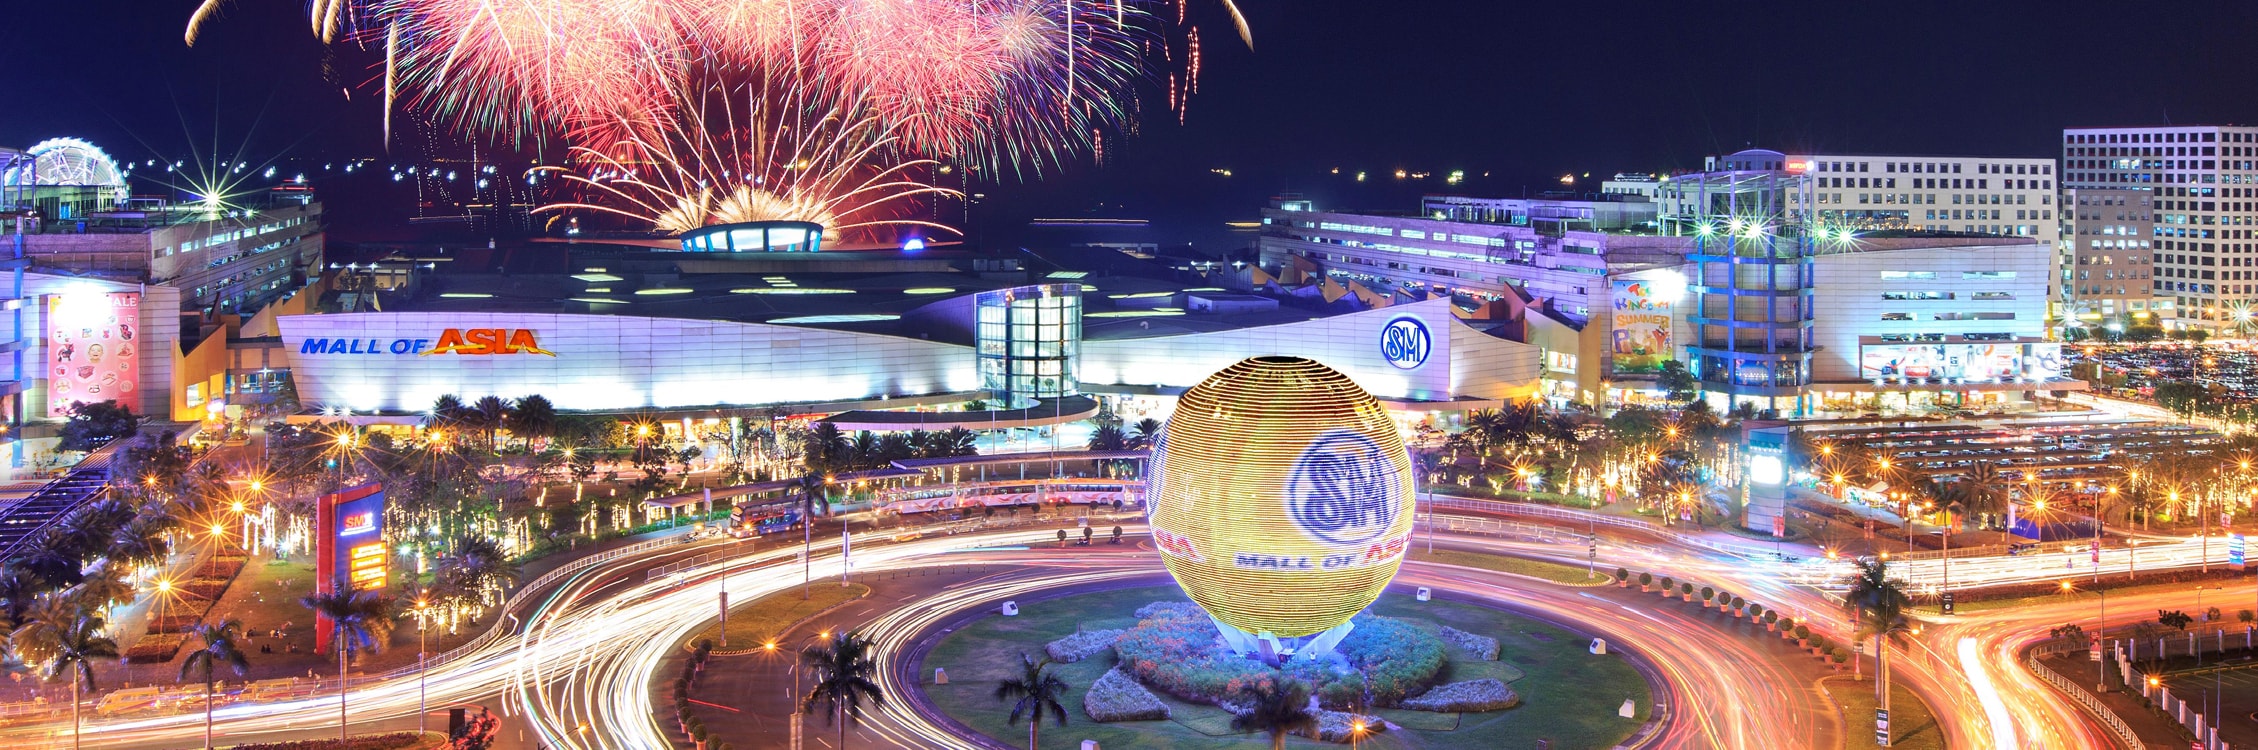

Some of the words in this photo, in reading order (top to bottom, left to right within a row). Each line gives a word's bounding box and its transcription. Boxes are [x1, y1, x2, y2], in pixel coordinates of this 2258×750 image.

[1616, 314, 1670, 328] SUMMER
[301, 338, 381, 354] MALL
[390, 338, 429, 354] OF
[432, 328, 544, 355] ASIA
[1385, 324, 1421, 363] SM
[1235, 553, 1313, 569] MALL
[1322, 552, 1358, 568] OF
